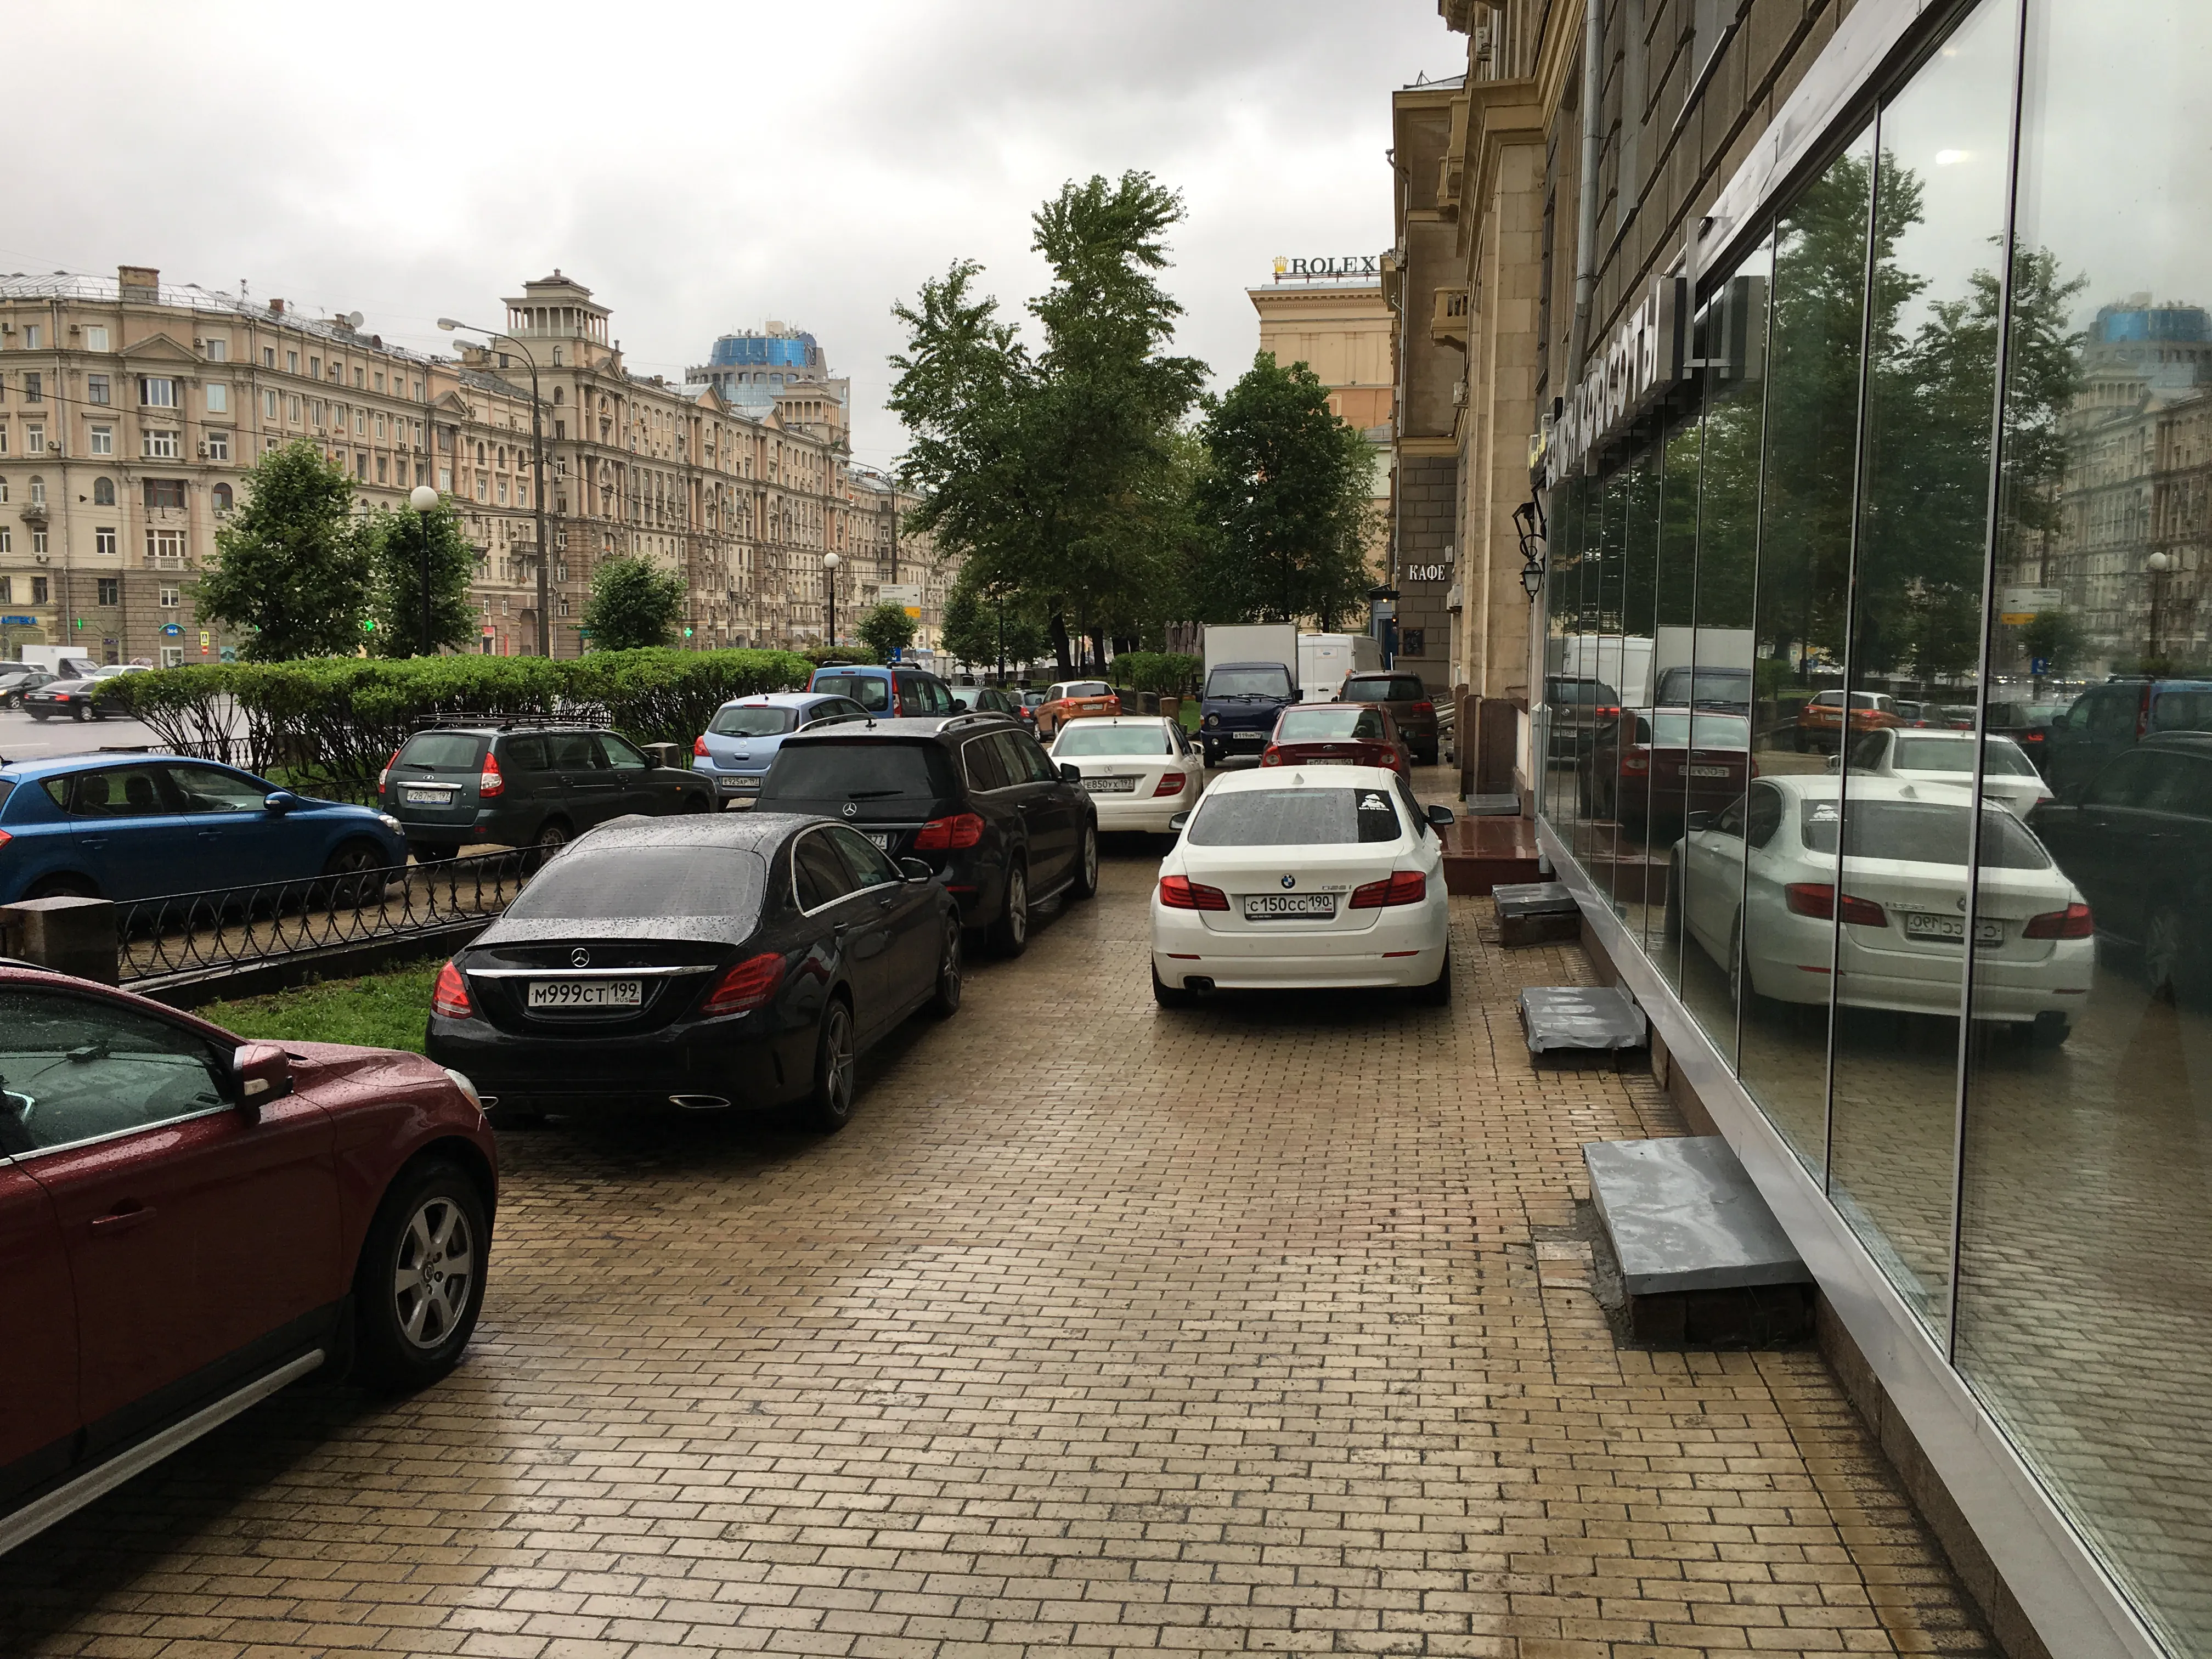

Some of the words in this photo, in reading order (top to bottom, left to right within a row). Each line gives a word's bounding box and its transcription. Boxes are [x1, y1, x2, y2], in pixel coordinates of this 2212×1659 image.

[1291, 256, 1376, 274] ROLEX
[1408, 565, 1445, 580] КАФЕ
[1308, 896, 1329, 907] 190
[610, 983, 637, 997] 199
